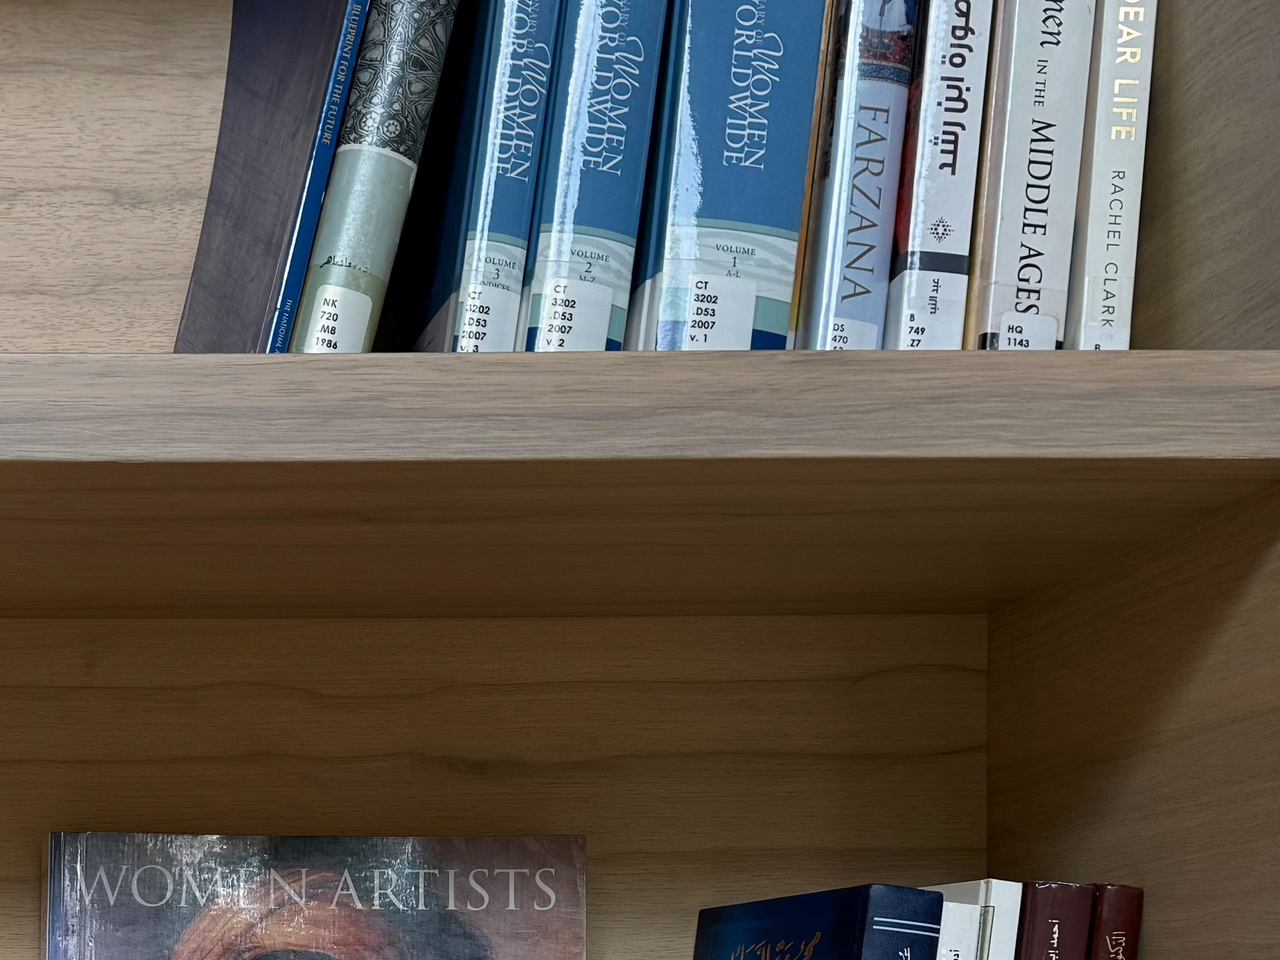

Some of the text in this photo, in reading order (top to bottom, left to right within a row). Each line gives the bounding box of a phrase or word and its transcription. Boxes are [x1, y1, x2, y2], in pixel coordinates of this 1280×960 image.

[319, 3, 364, 145] BLUEPRINT FOR THE FUTURE
[933, 72, 974, 115] ابن
[1111, 78, 1138, 142] LIFE
[1015, 60, 1058, 315] IN THE MIDDLE AGES
[841, 102, 891, 303] FARZANA
[1106, 170, 1126, 251] RACHEL
[570, 248, 610, 263] VOLUME
[715, 244, 756, 256] VOLUME
[584, 262, 592, 274] 2
[493, 269, 500, 280] 3
[554, 284, 567, 294] CT
[695, 279, 709, 291] CT
[322, 298, 338, 308] NK
[551, 298, 577, 309] 3202
[693, 293, 719, 305] 3202
[320, 311, 339, 322] 720
[549, 311, 574, 322] .D53
[692, 306, 716, 318] .D53
[317, 324, 336, 335] .M8
[547, 324, 572, 335] 2007
[690, 319, 716, 330] 2007
[833, 322, 845, 333] DS
[908, 324, 926, 335] 749
[1007, 323, 1024, 334] HQ
[462, 330, 487, 341] 2007
[832, 334, 848, 344] 470
[315, 336, 338, 350] 1986
[907, 338, 922, 348] .Z7
[1007, 337, 1030, 348] 1143
[72, 863, 558, 912] WOMEN ARTISTS
[1045, 918, 1060, 947] أحمد
